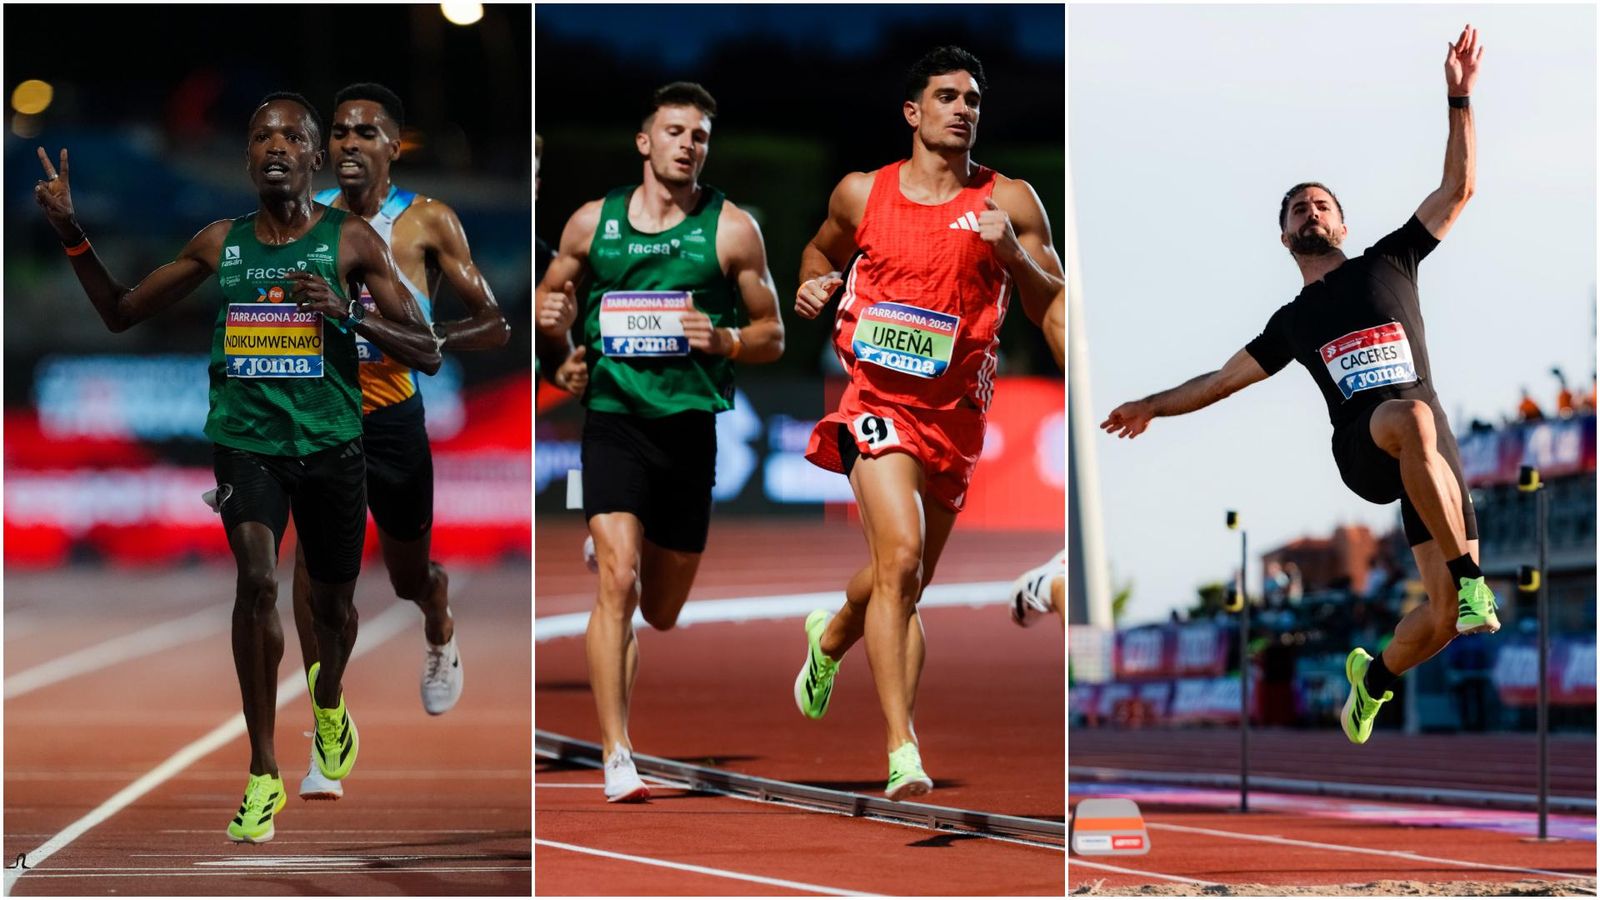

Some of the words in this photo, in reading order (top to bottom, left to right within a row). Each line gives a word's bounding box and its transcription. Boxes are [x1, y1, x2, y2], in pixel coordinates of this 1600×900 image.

[230, 312, 291, 323] TARRAGONA
[292, 312, 318, 323] 2025
[627, 315, 662, 330] BOIX
[868, 306, 927, 326] TARRAGONA
[927, 318, 953, 332] 2025
[225, 335, 321, 349] NDIKUMWENAYO
[872, 326, 934, 358] UREÑA
[1340, 345, 1398, 370] CACERES
[861, 415, 888, 444] 9
